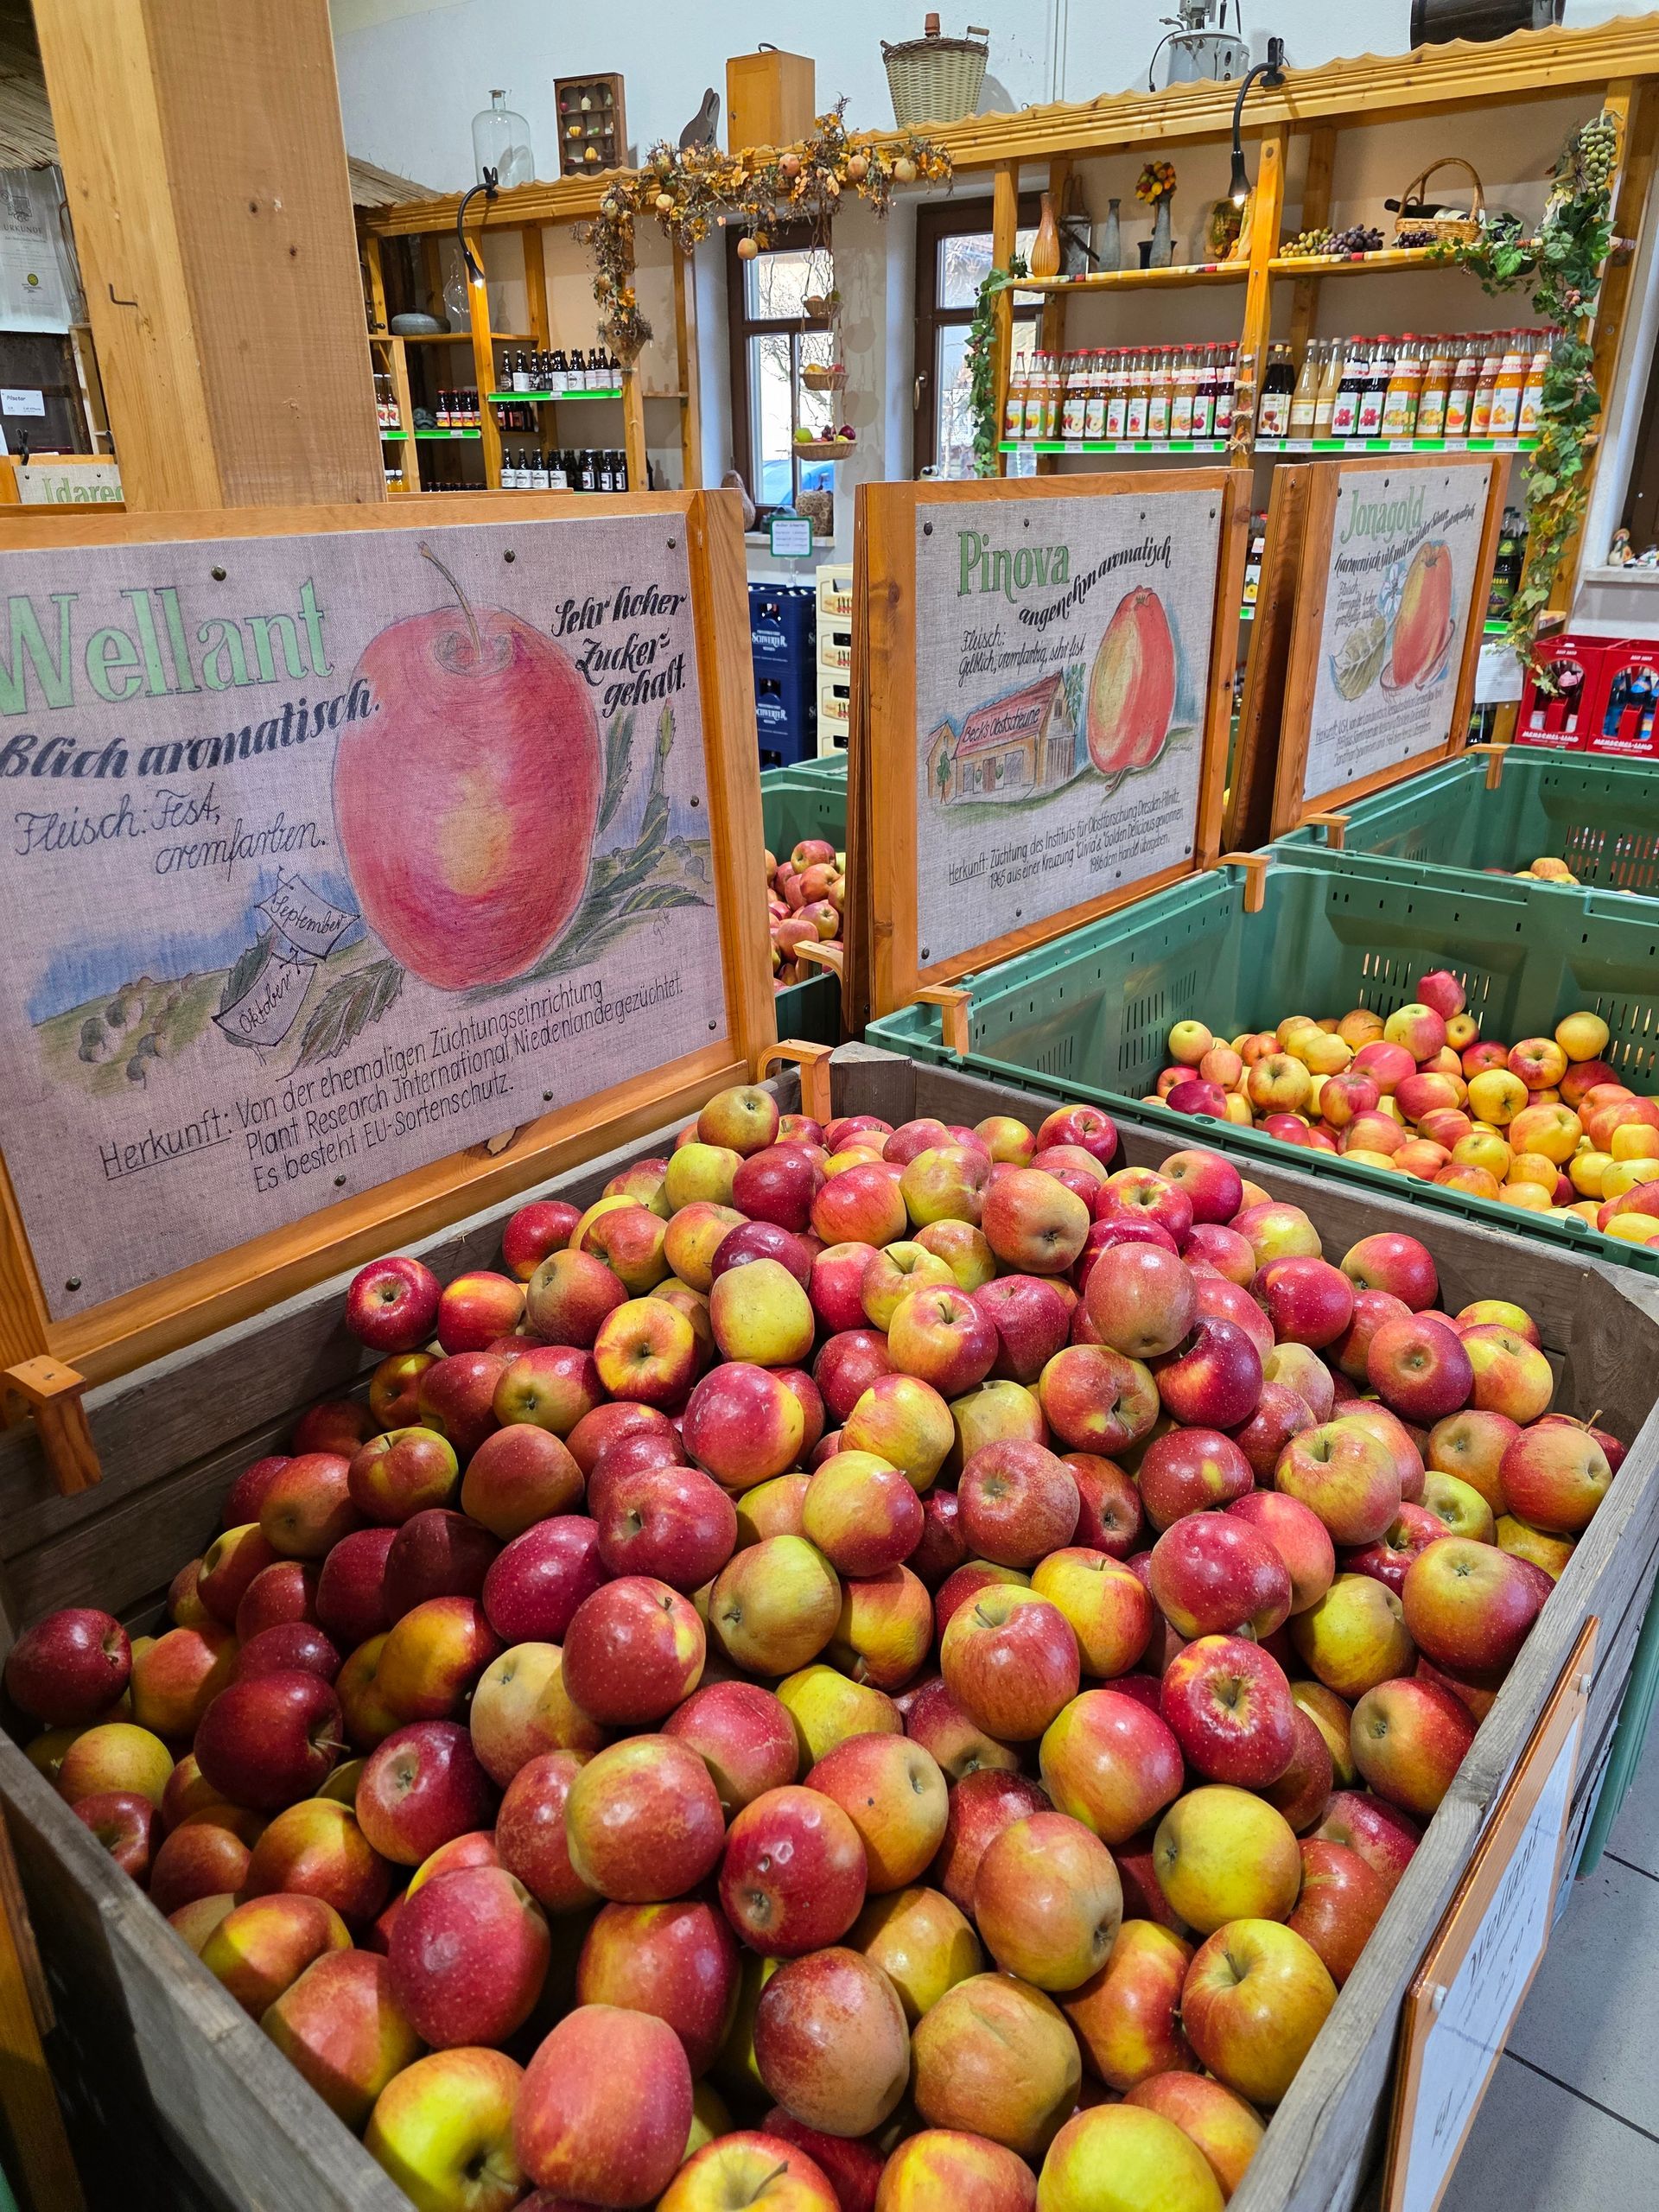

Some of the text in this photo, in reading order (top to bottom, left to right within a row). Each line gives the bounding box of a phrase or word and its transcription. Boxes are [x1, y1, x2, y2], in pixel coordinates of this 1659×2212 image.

[4, 223, 42, 234] URKUNDE
[1341, 485, 1427, 544] Jonagold
[957, 531, 1070, 603] Pinova
[1019, 535, 1171, 632] angenehm aromatisch
[1395, 537, 1408, 563] mit
[551, 583, 687, 638] Sehr hoher
[961, 624, 1007, 652] Fleisch:
[0, 577, 334, 716] Wellant
[602, 652, 687, 718] gehalt.
[137, 678, 380, 777] aromatisch.
[15, 781, 220, 855] Fleisch: Fest,
[949, 851, 988, 884] Herkunft:
[989, 842, 1028, 870] Züchtung
[1029, 834, 1044, 855] des
[1045, 823, 1076, 850] Instituts
[1077, 820, 1089, 839] für
[1088, 805, 1137, 835] Obstforschung
[989, 868, 1006, 890] 1965
[1007, 866, 1021, 884] aus
[1022, 861, 1040, 880] einer
[270, 895, 347, 934] September
[238, 969, 291, 1034] Oktober
[99, 979, 604, 1179] Herkunft: Von der ehemaligen Züchtungseinrichtung
[246, 1116, 300, 1160] Plant
[305, 1082, 389, 1139] Research
[513, 1000, 613, 1055] Niederlande
[614, 970, 683, 1024] gezüchtet.
[253, 1071, 514, 1193] Es besteht EU-Sortenschutz.
